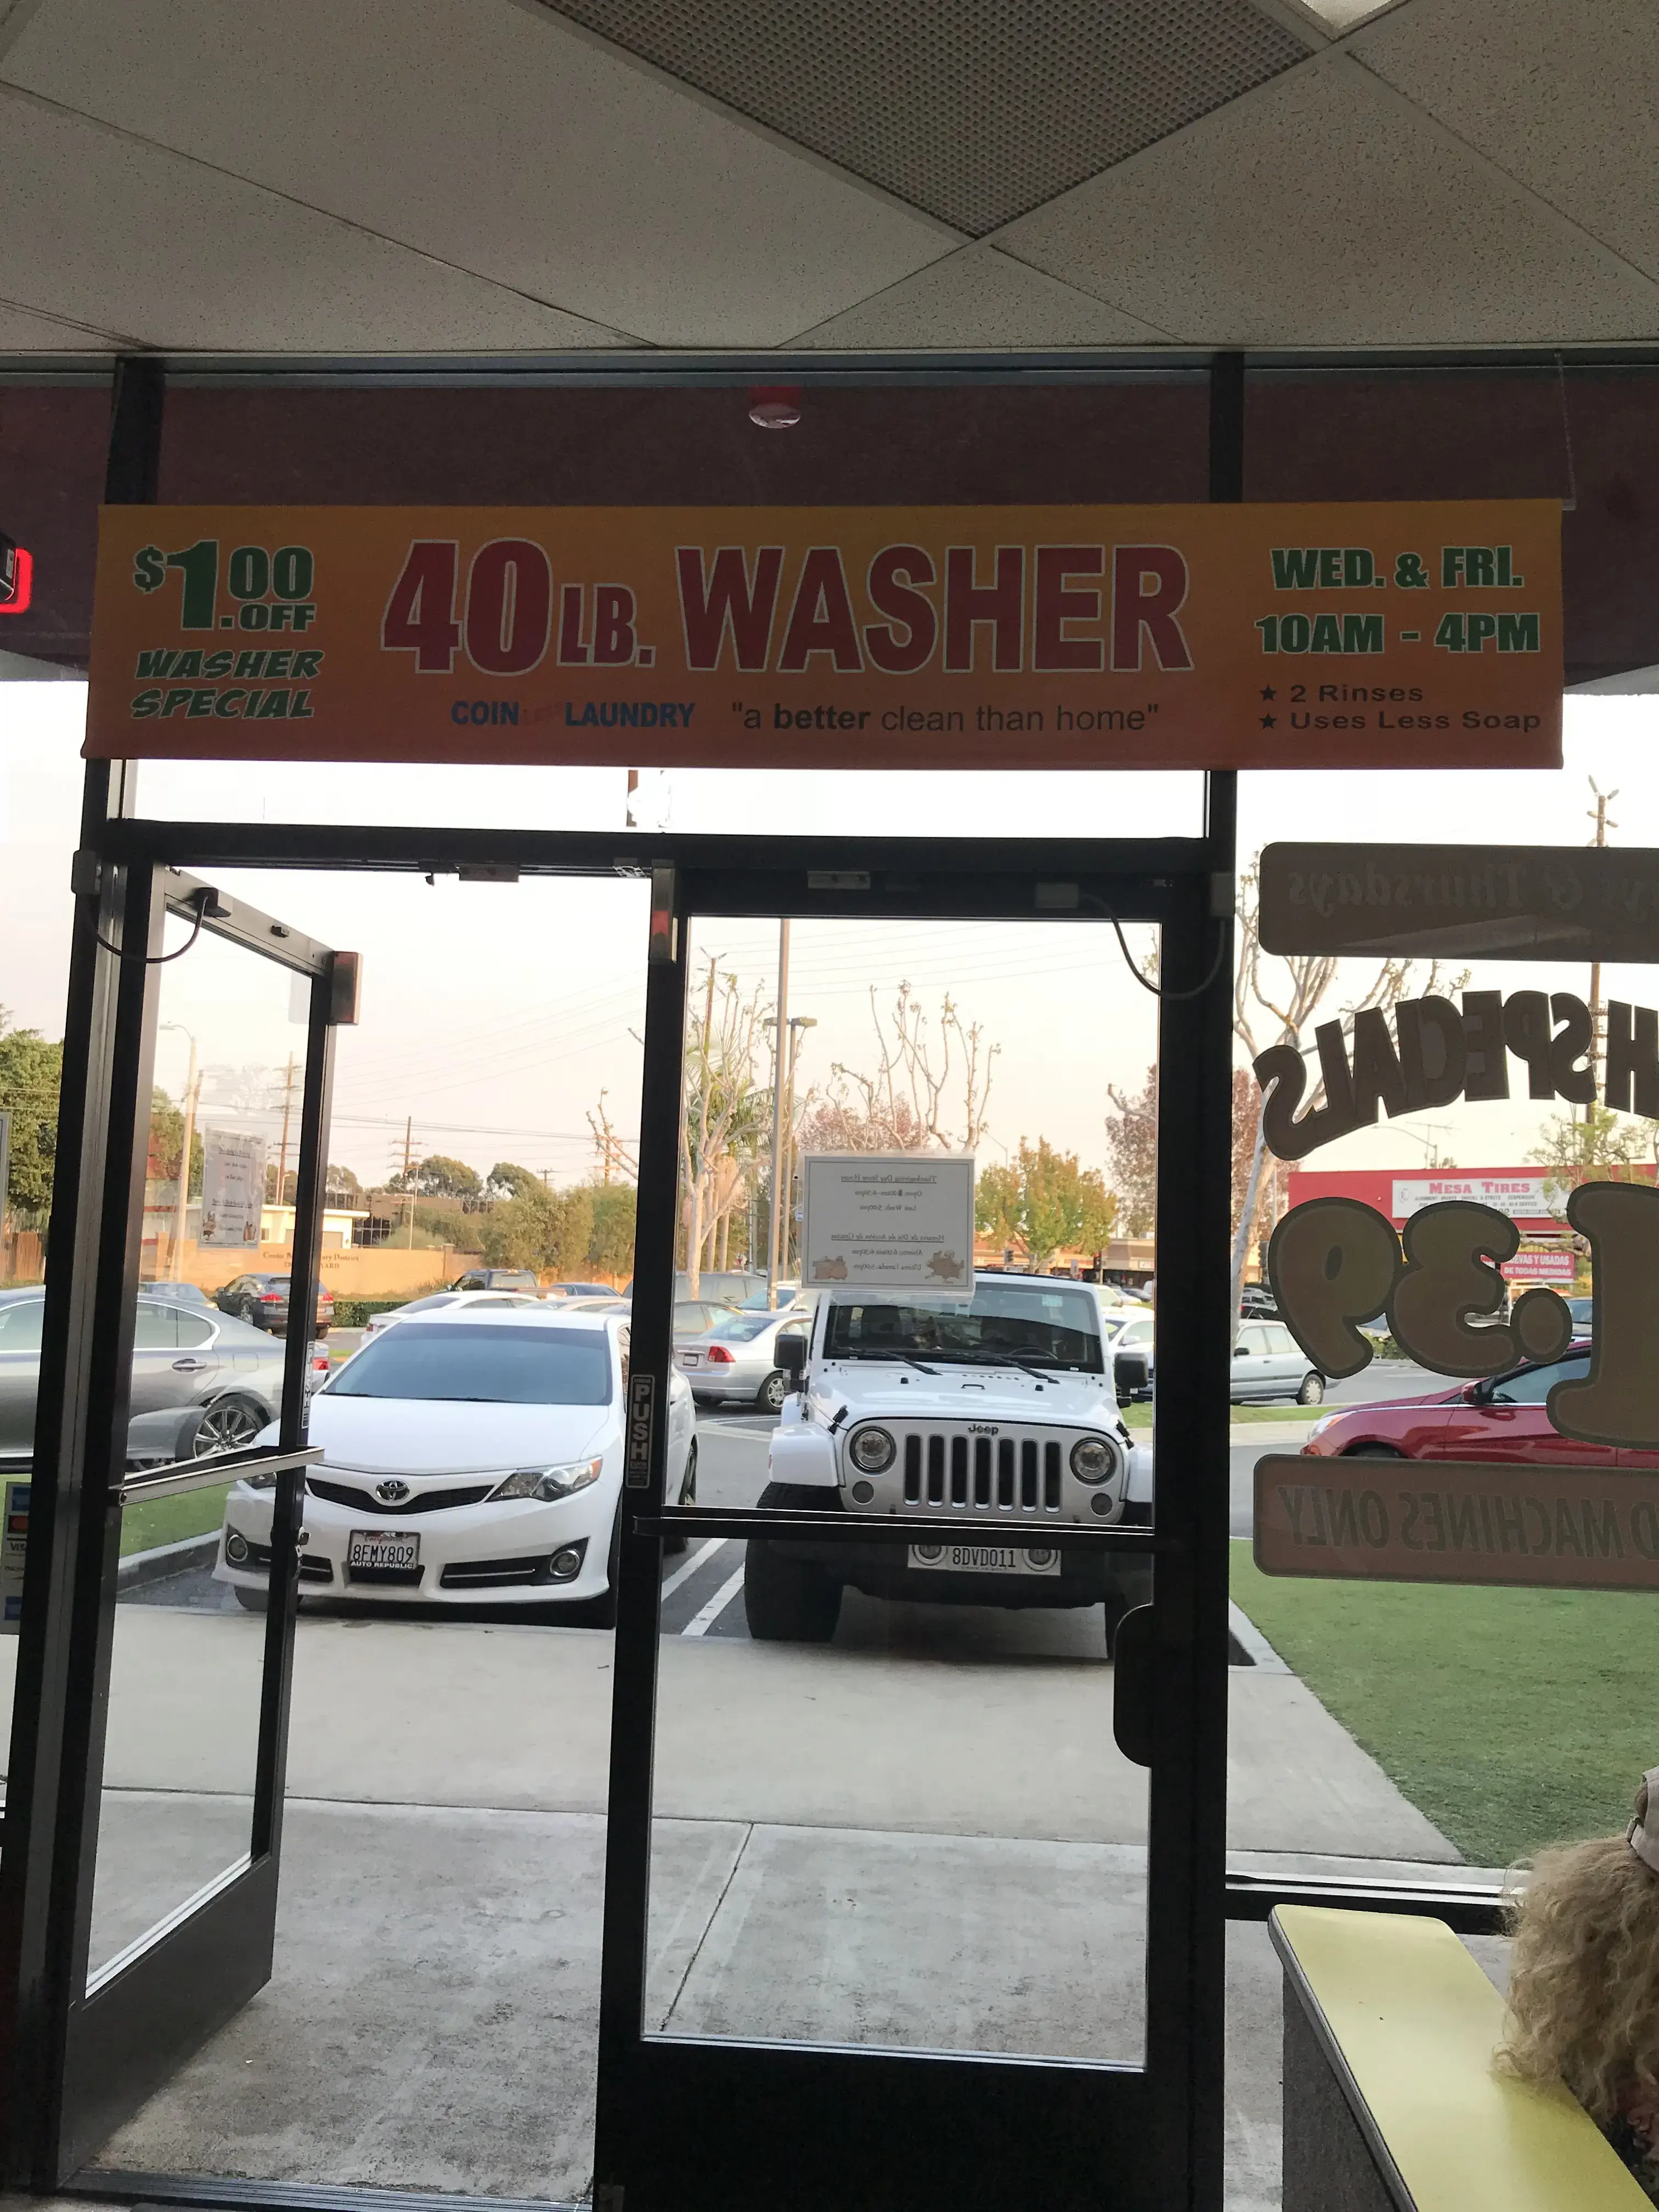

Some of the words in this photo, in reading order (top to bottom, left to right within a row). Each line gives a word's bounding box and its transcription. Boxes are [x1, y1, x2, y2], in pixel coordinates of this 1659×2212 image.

[1271, 549, 1386, 590] WED.
[1394, 552, 1430, 590] &
[1441, 546, 1524, 589] FRI.
[674, 544, 1194, 674] WASHER
[1255, 614, 1385, 654] 10AM
[1400, 630, 1421, 641] -
[1434, 613, 1541, 653] 4PM
[134, 648, 325, 680] WASHER
[131, 688, 315, 719] SPECIAL
[1290, 685, 1306, 702] 2
[1319, 685, 1423, 702] Rinses
[452, 701, 519, 725] COIN
[565, 703, 696, 728] LAUNDRY
[732, 702, 761, 730] "a
[774, 703, 870, 730] better
[881, 706, 963, 731] clean
[977, 706, 1043, 731] than
[1057, 704, 1159, 732] home"
[1291, 712, 1365, 730] Uses
[1379, 712, 1449, 730] Less
[1462, 712, 1541, 733] Soap
[1429, 1182, 1472, 1195] MESA
[1481, 1181, 1531, 1194] TIRES
[1534, 1255, 1538, 1264] Y
[1540, 1255, 1570, 1266] USADAS
[630, 1384, 650, 1460] PUSH
[968, 1423, 999, 1436] Jeep
[353, 1544, 414, 1564] 8FMY809
[952, 1547, 1016, 1568] 8DVD011
